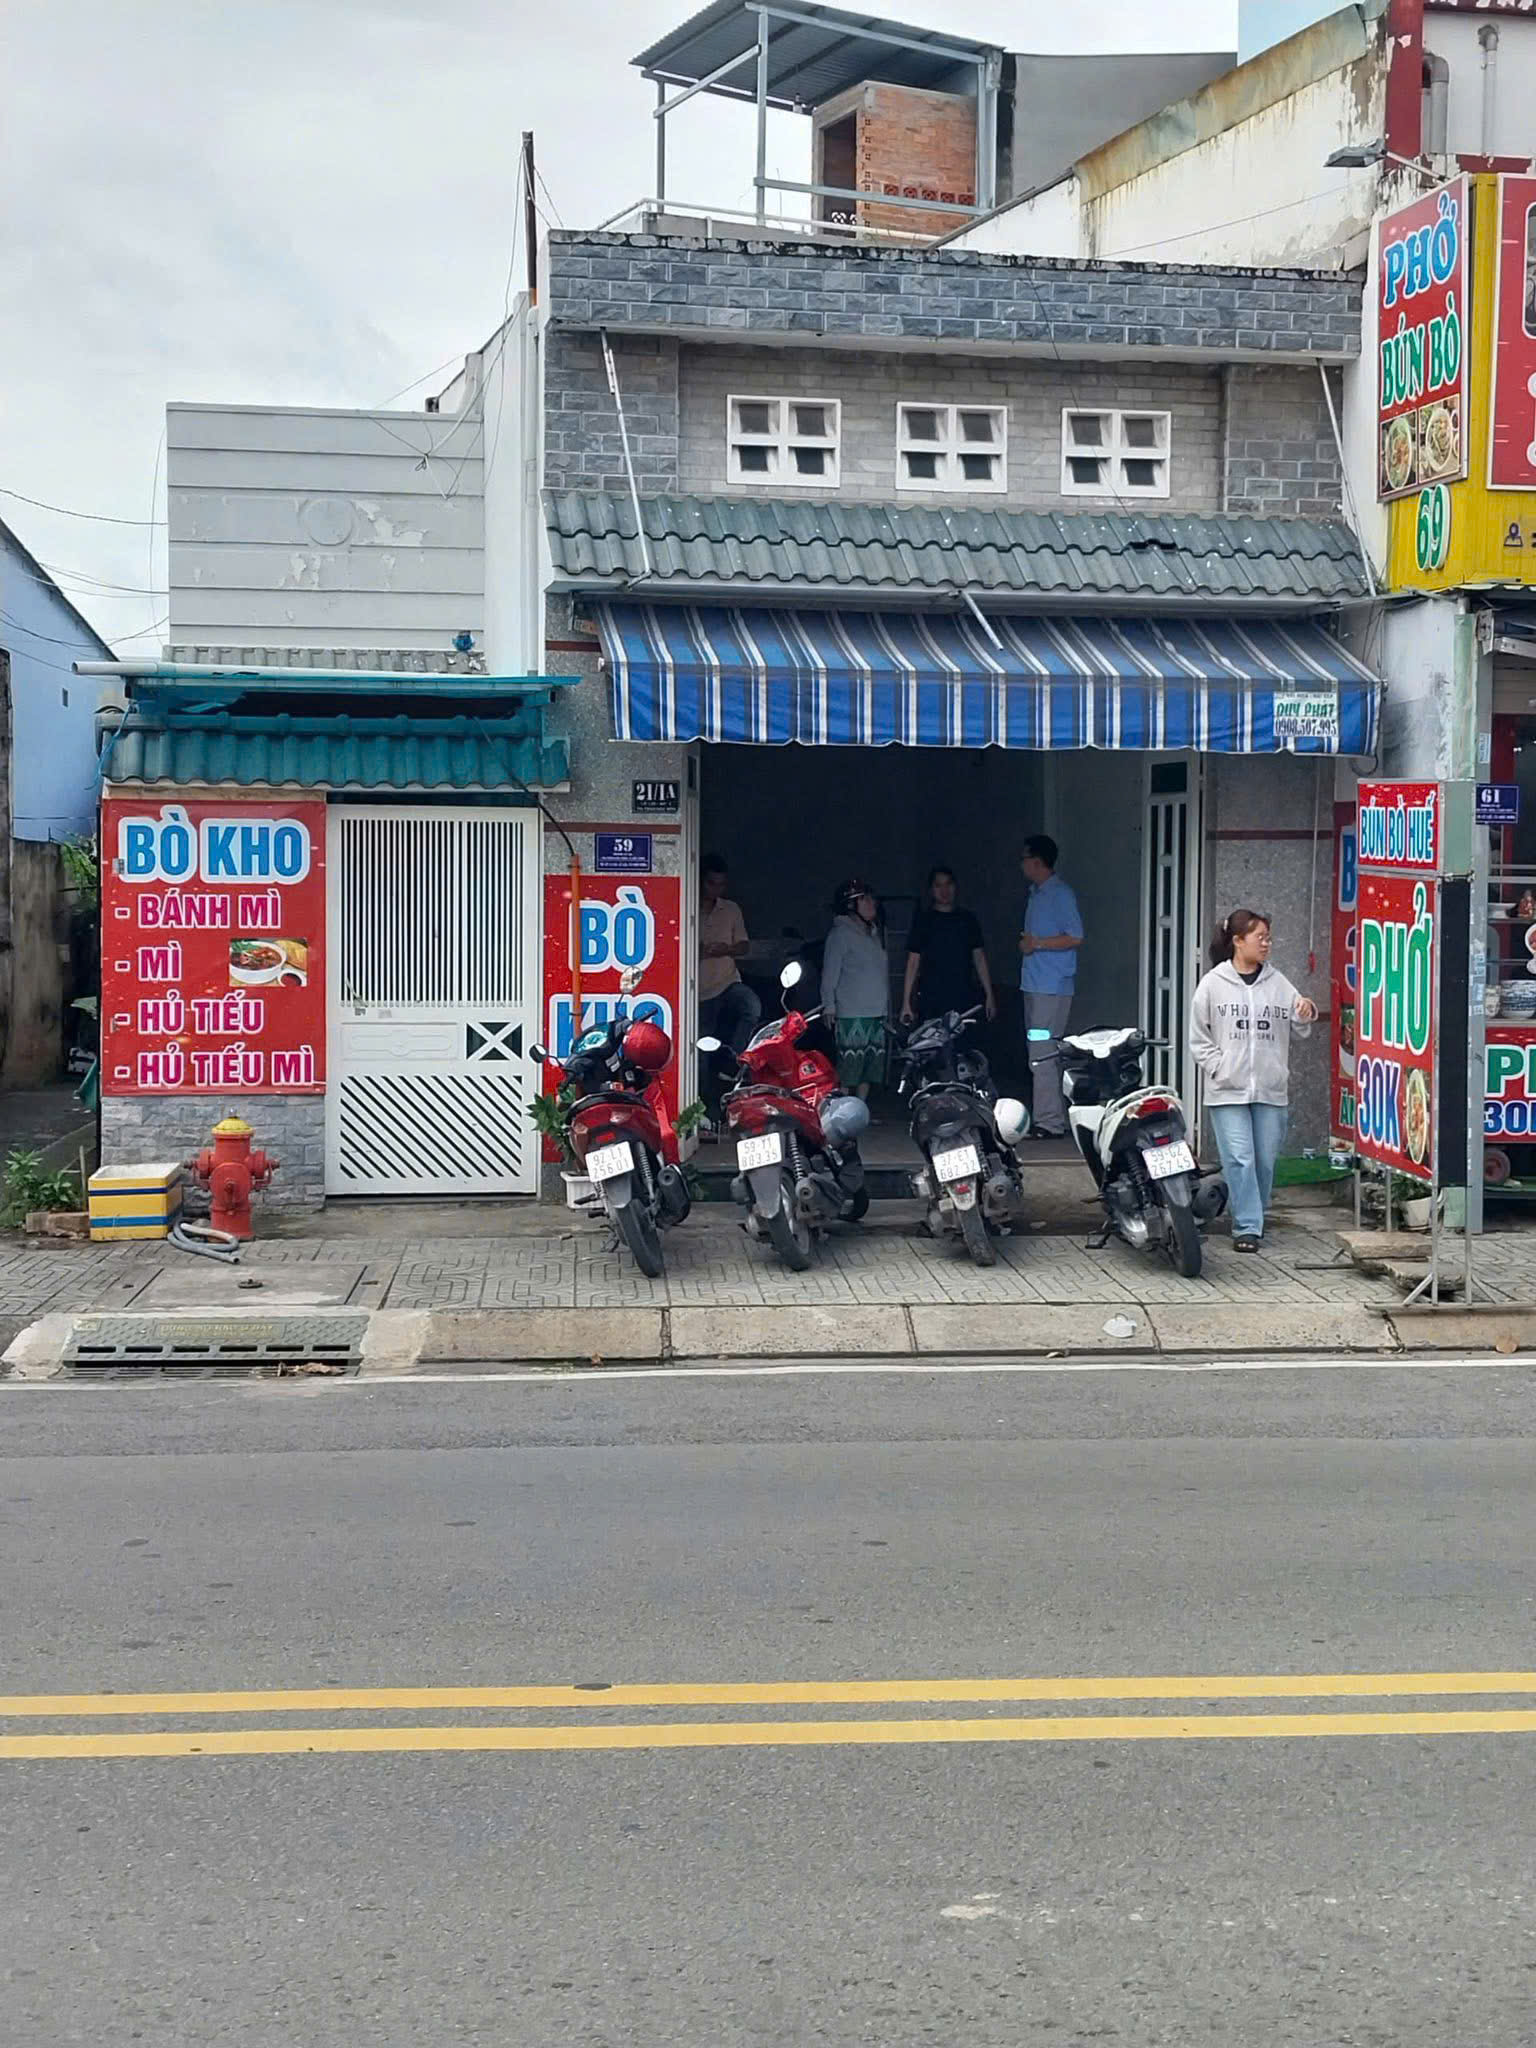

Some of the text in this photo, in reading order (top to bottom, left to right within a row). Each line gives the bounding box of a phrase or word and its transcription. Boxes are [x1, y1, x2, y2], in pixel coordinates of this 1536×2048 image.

[1384, 191, 1457, 308] PHỞ
[1381, 291, 1460, 409] BÚN BÒ
[1416, 483, 1448, 572] 69
[636, 783, 677, 801] 21/1A
[1360, 790, 1435, 863] BÚN BÒ HUẾ
[1481, 788, 1501, 804] 61
[121, 807, 308, 882] BÒ KHO
[613, 838, 634, 853] 59
[138, 888, 281, 928] BÁNH MÌ
[574, 887, 651, 970] BÒ
[138, 941, 182, 981] MÌ
[1361, 882, 1432, 1056] PHỞ
[138, 989, 264, 1034] HỦ TIẾU
[138, 1041, 315, 1087] HỦ TIẾU MÌ
[1357, 1053, 1402, 1153] 30K
